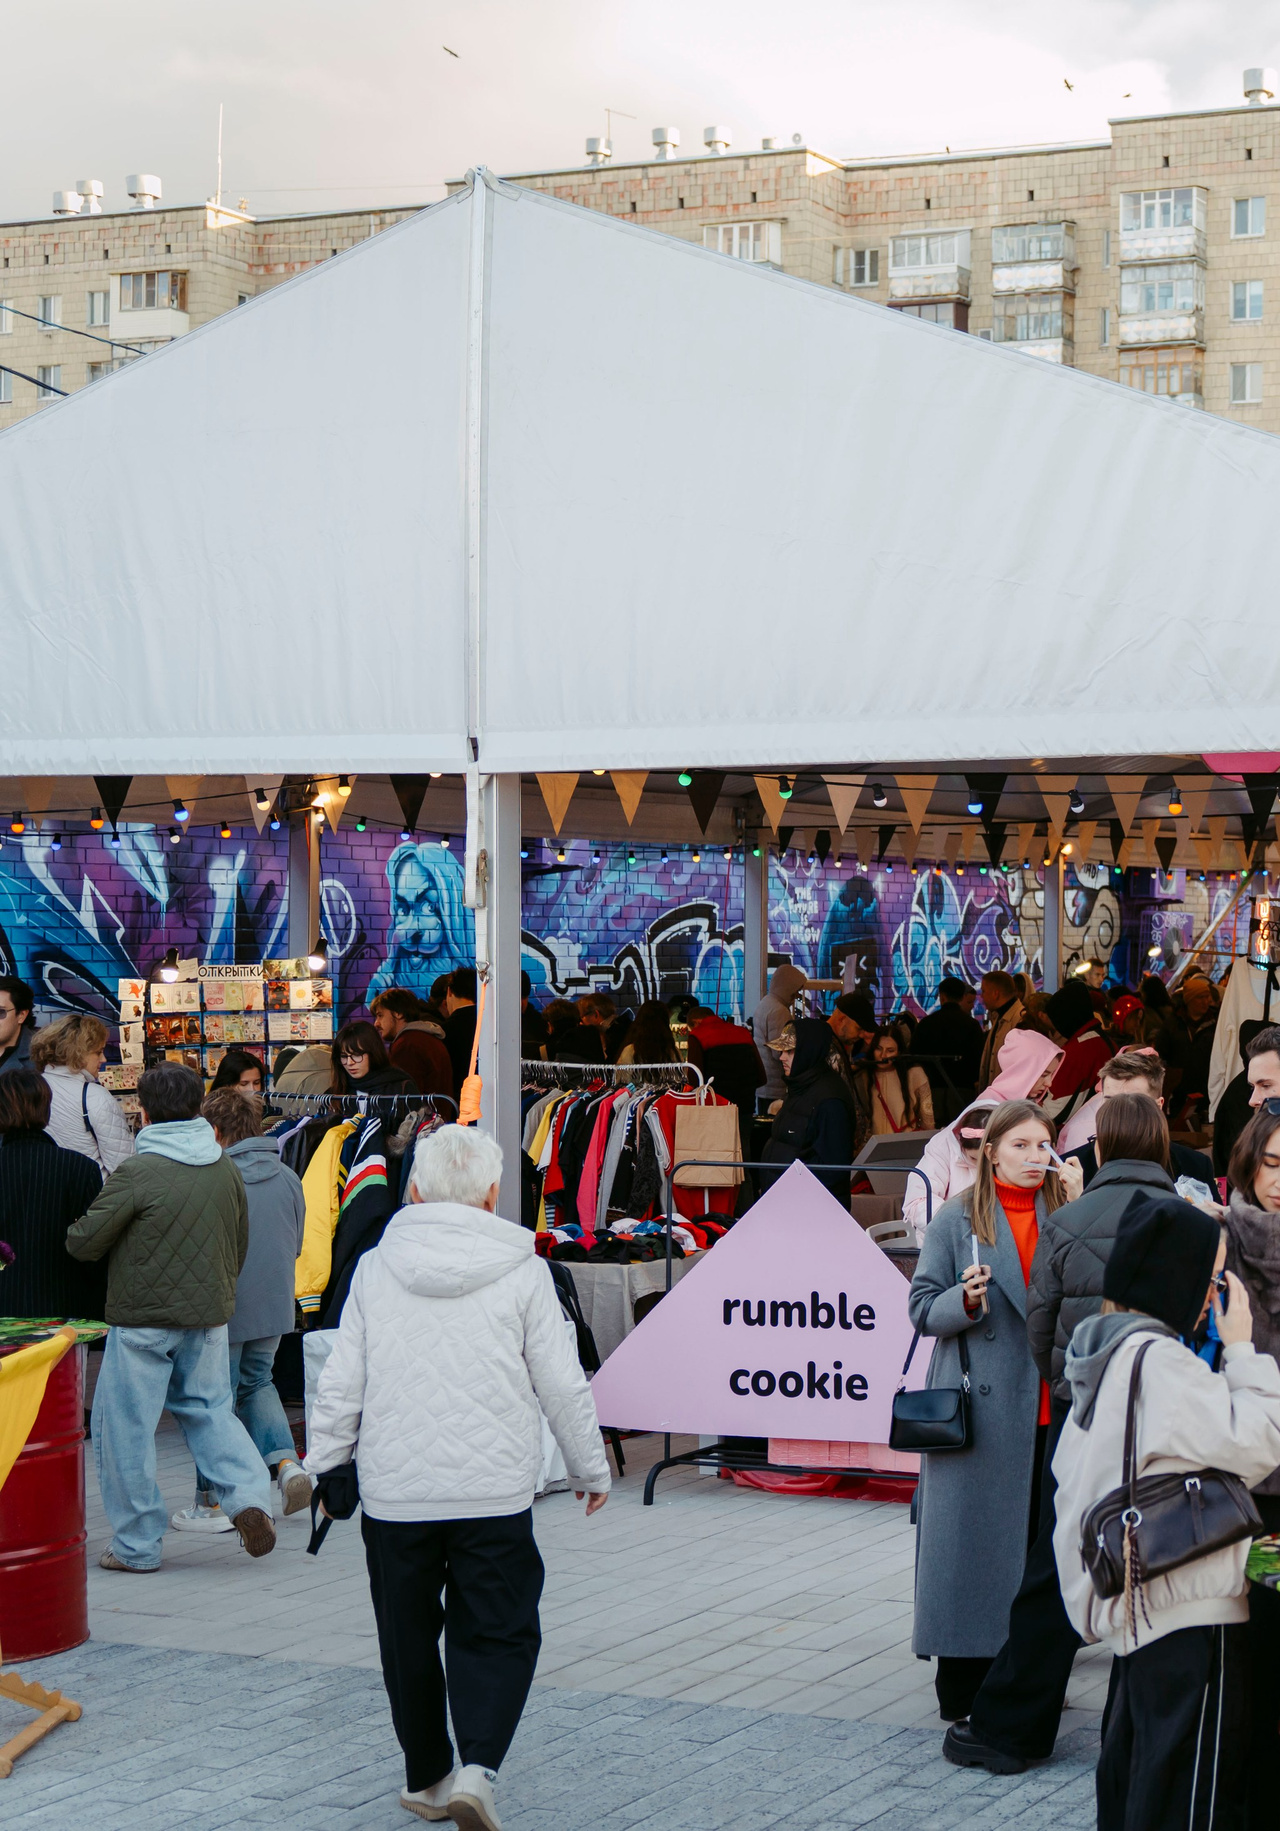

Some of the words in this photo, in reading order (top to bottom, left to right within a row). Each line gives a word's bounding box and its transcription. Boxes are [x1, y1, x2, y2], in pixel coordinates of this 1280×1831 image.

[794, 887, 812, 901] THE
[788, 899, 818, 915] FUTURE
[800, 913, 809, 926] IS
[790, 924, 820, 943] MEOW
[198, 966, 263, 978] ОТКРЫТКИ
[722, 1291, 876, 1332] rumble
[729, 1360, 869, 1401] cookie
